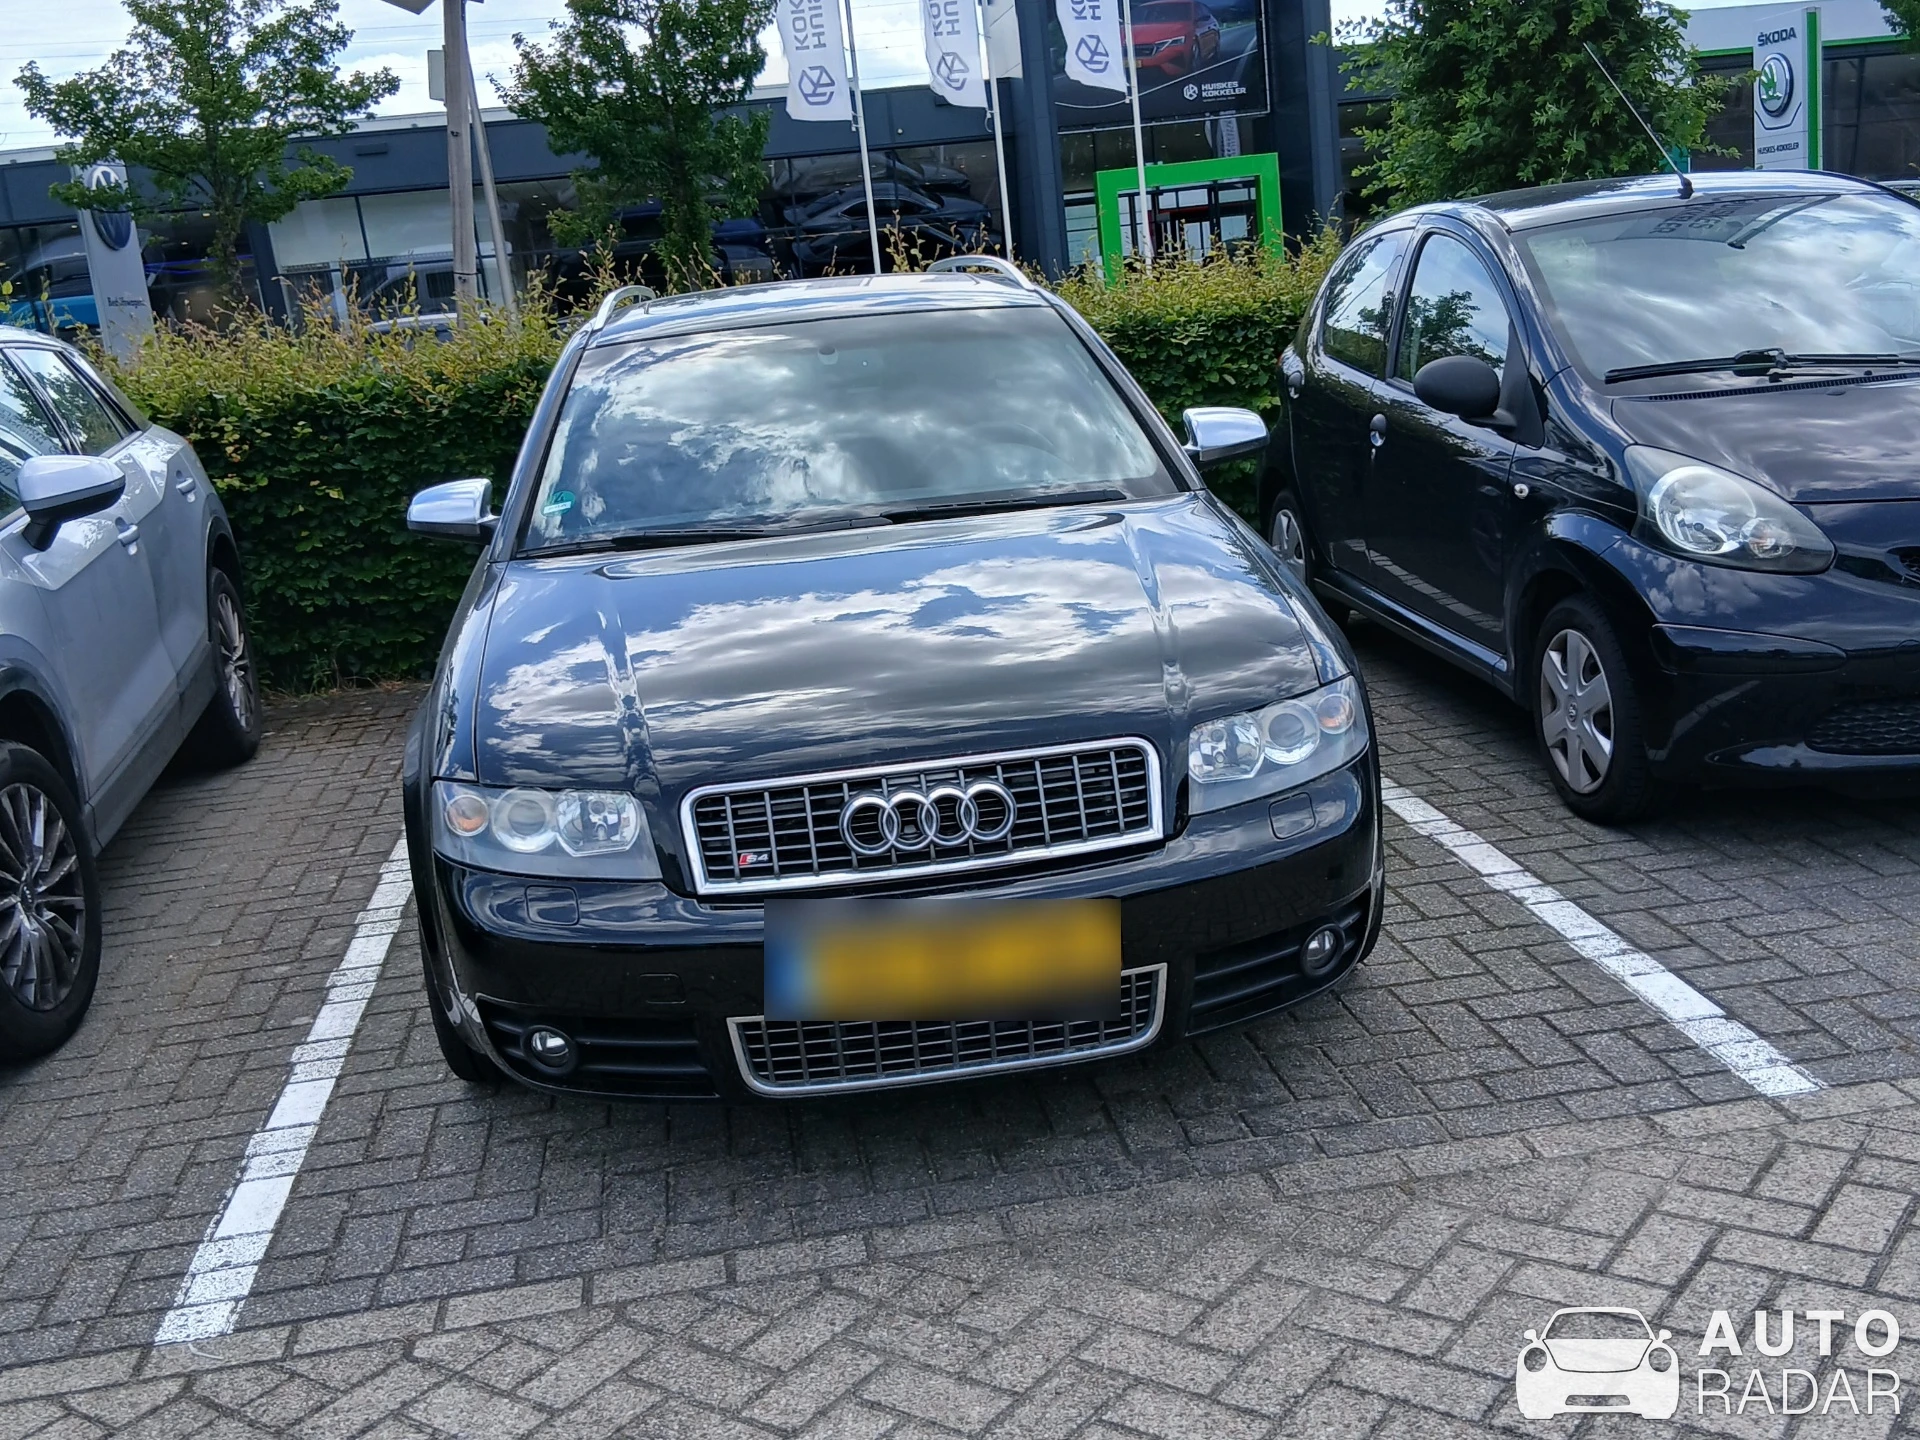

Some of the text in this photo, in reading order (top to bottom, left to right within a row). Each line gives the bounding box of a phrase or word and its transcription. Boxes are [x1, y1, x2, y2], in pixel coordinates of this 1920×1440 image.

[1757, 26, 1798, 47] ŠKODA
[1202, 81, 1239, 90] HUISKES
[1202, 87, 1247, 97] KOKKELER
[746, 854, 769, 863] S4
